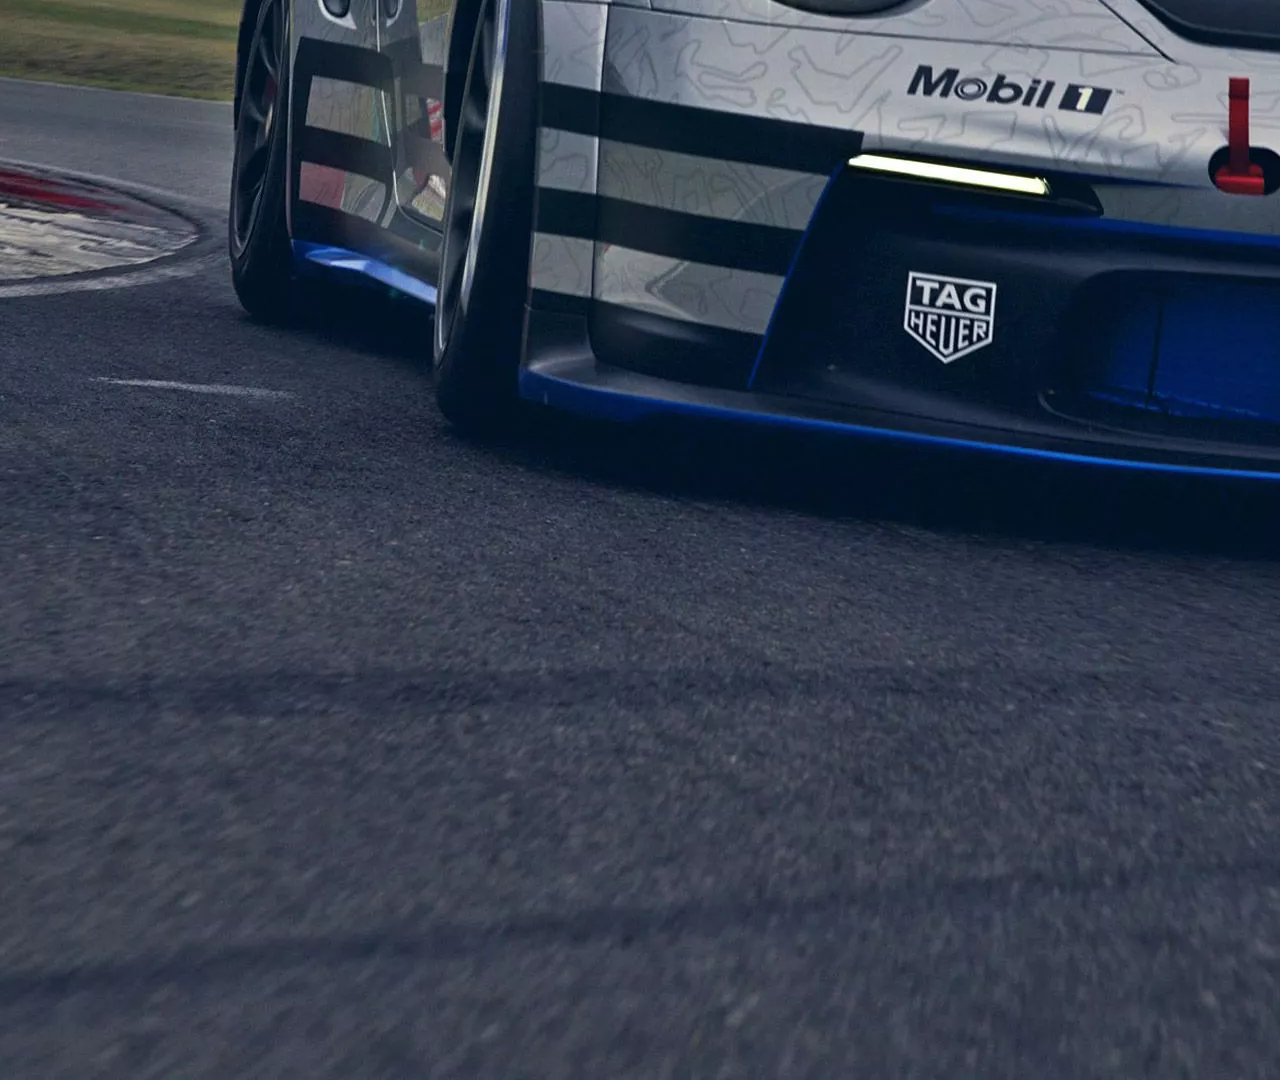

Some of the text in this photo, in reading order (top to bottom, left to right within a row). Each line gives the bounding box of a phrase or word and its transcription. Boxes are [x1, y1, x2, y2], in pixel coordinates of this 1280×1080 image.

[907, 65, 1055, 109] Mobil
[915, 279, 987, 313] TAG
[910, 311, 987, 355] HEUER
